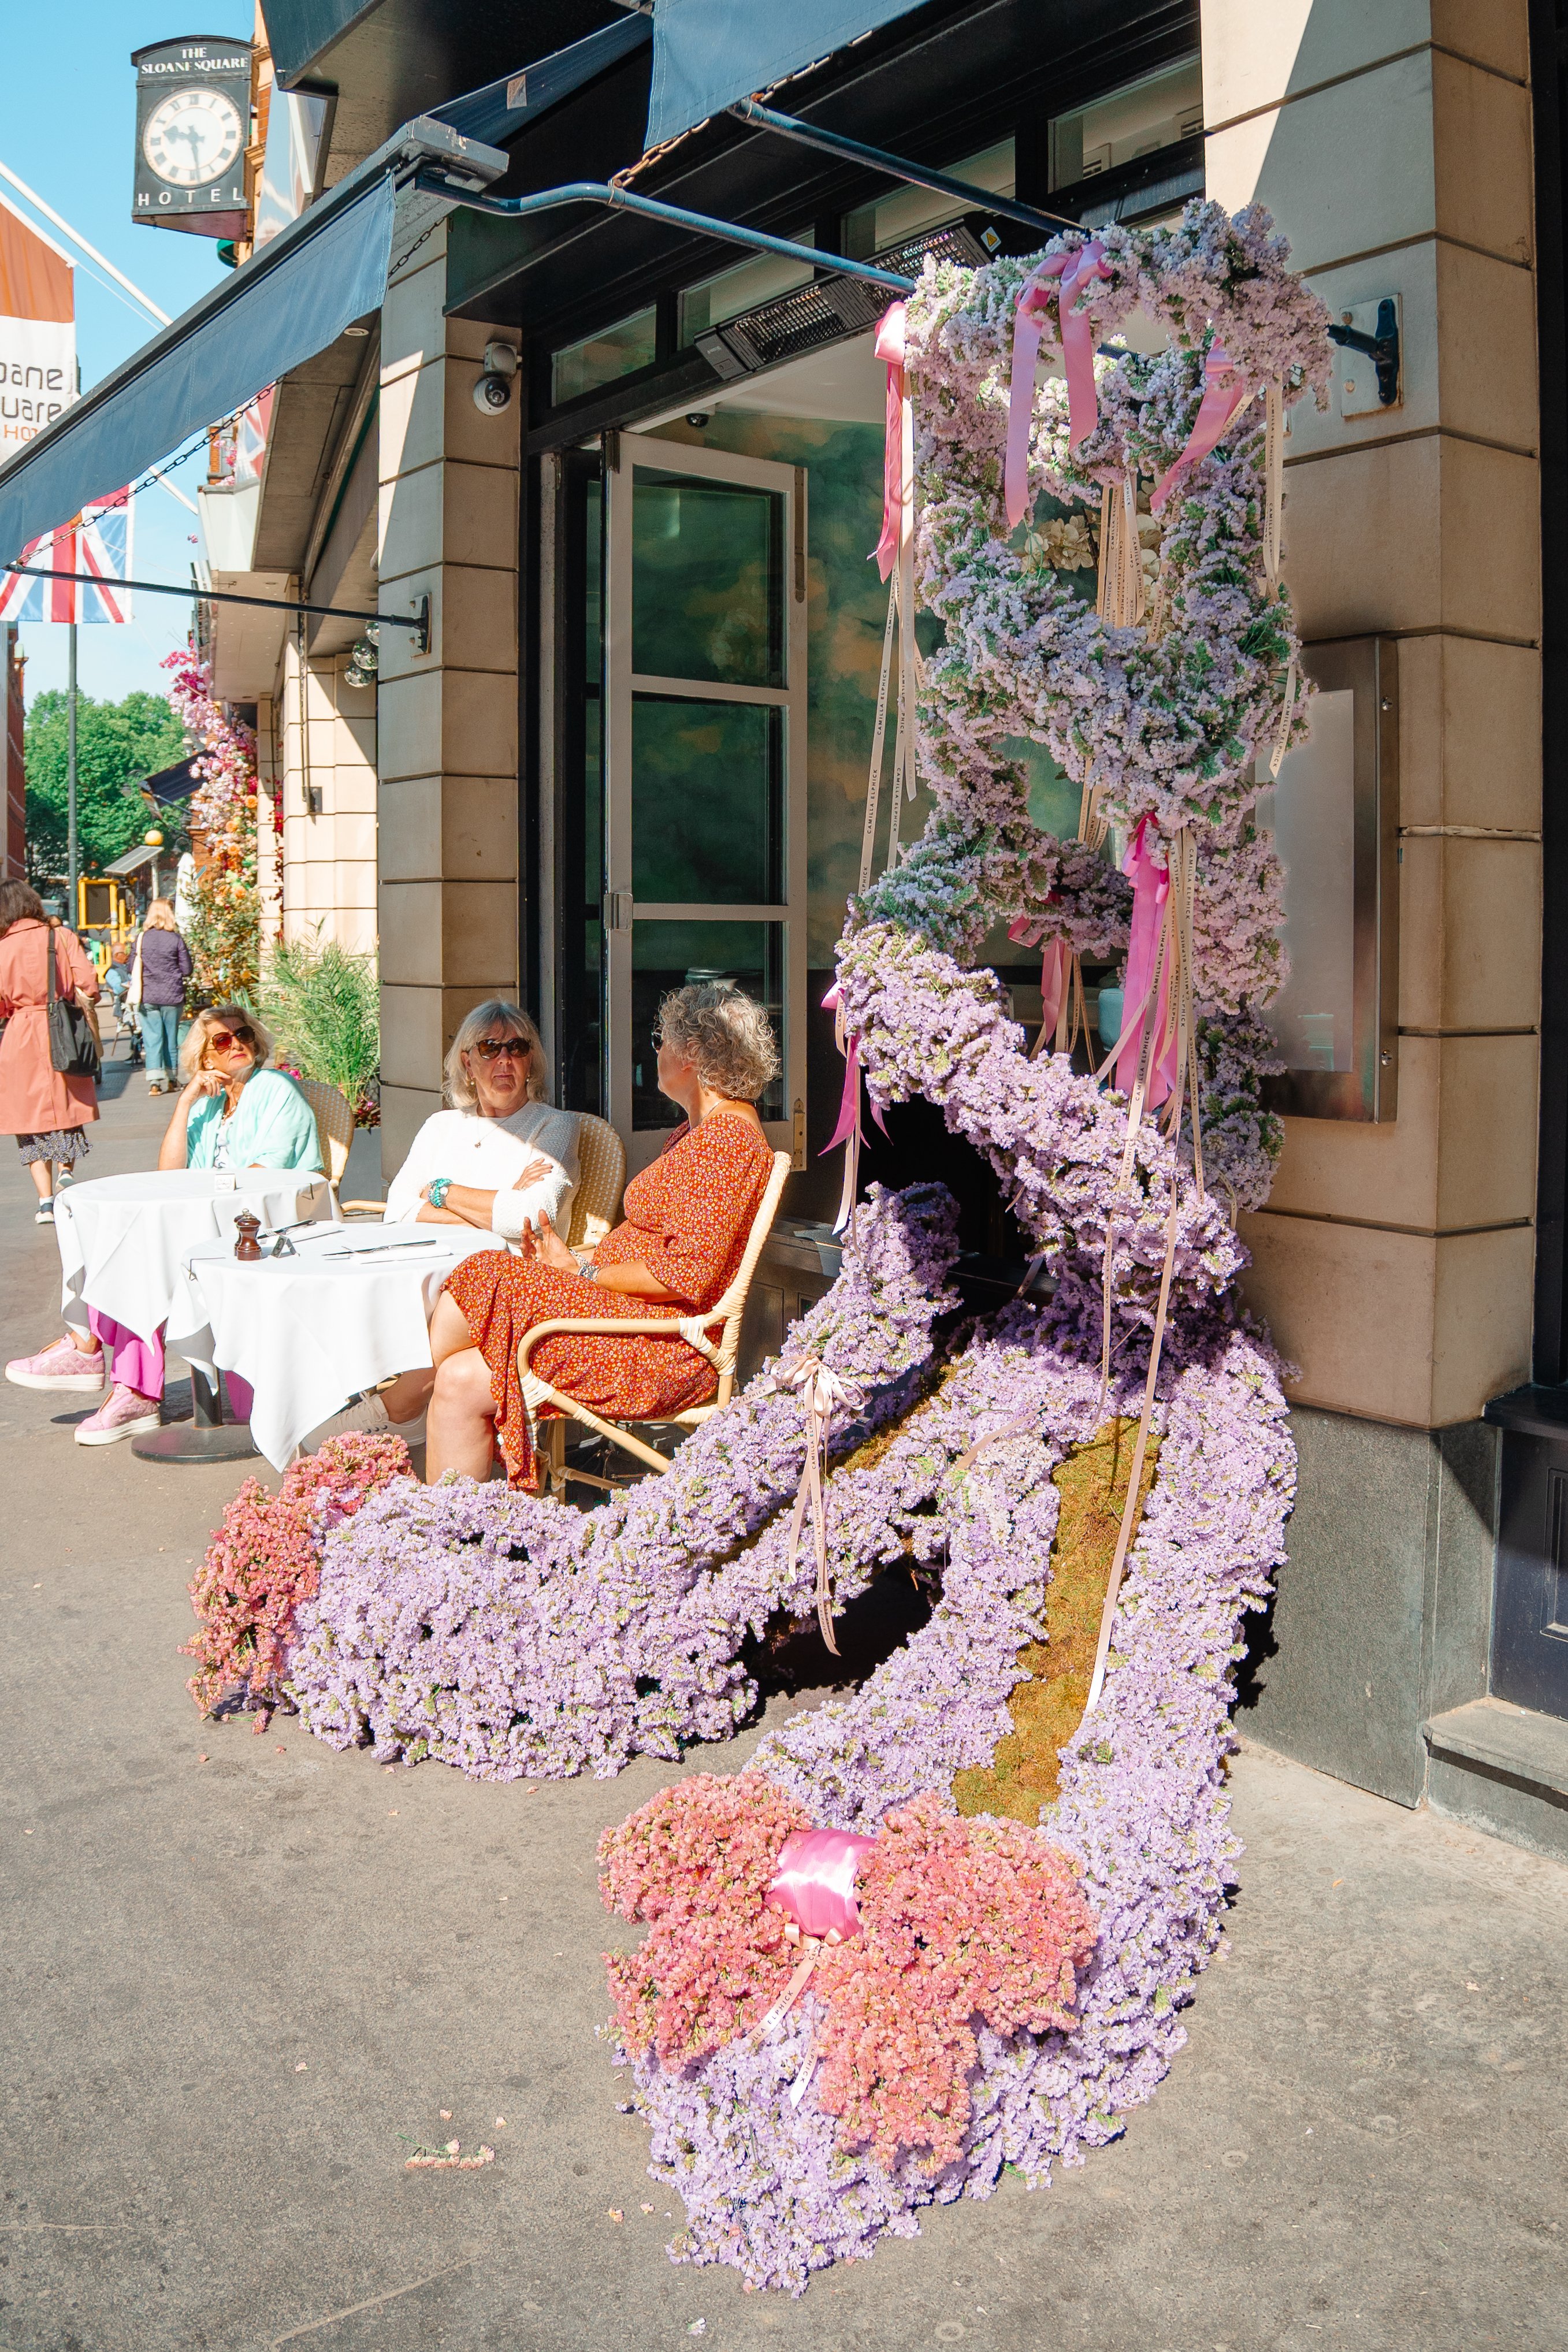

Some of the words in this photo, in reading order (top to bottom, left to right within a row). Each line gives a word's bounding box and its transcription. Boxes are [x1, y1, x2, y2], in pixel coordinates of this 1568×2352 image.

[180, 47, 207, 59] THE
[194, 57, 248, 72] SQUARE
[138, 187, 243, 207] HOTEL
[1152, 607, 1160, 637] CAMILLA
[915, 657, 925, 684] CAMILLA
[1281, 700, 1292, 733] CAMILLA
[1152, 961, 1162, 995] CAMILLA
[1159, 924, 1167, 957] ELPHICK
[1169, 1002, 1177, 1035] ELPHICK
[1136, 1068, 1145, 1101] CAMILLA
[1141, 1031, 1151, 1064] ELPHICK
[1125, 1138, 1134, 1170] ELPHICK
[742, 1388, 767, 1403] ELPHICK
[767, 1991, 794, 2025] ELPHICK
[801, 2048, 816, 2083] LPHICK
